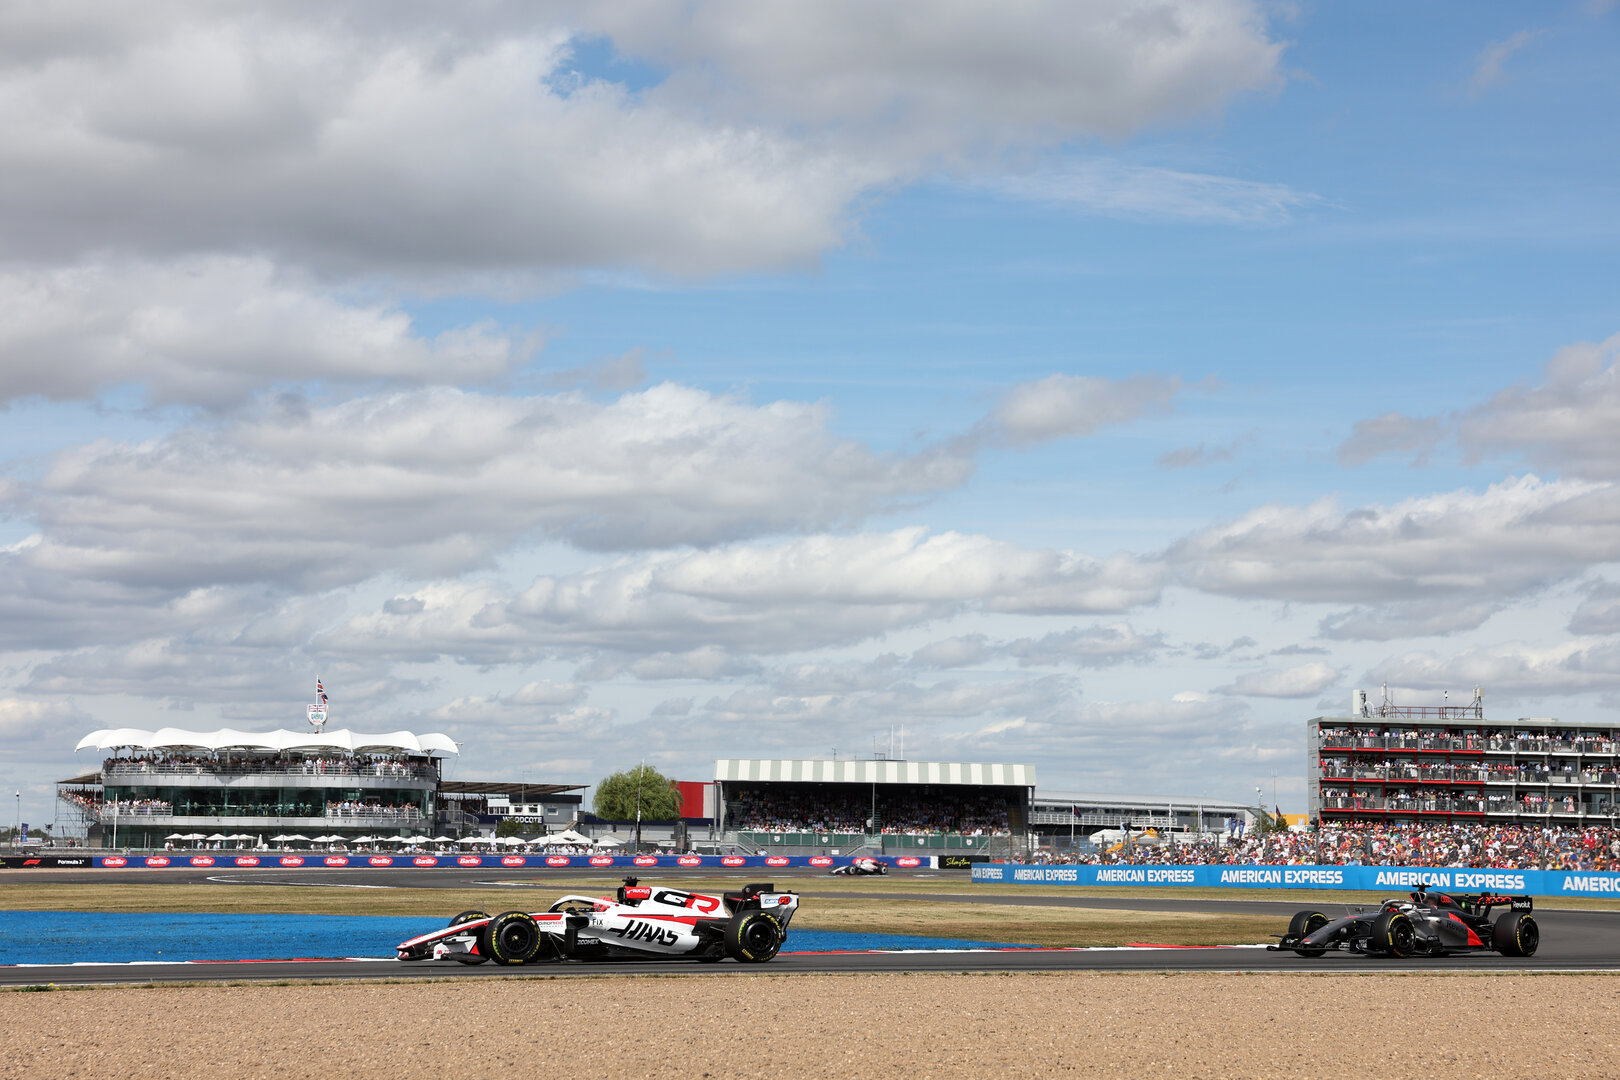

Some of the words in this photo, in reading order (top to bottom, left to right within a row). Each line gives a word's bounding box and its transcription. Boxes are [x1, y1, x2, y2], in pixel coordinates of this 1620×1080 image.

[502, 816, 543, 824] WODCOTE
[1014, 869, 1045, 881] AMERICAN
[1045, 869, 1078, 882] EXPRESS
[1096, 869, 1145, 882] AMERICAN
[1147, 870, 1195, 883] EXPRESS
[1221, 870, 1281, 883] AMERICAN
[1284, 871, 1343, 884] EXPRESS
[1375, 871, 1451, 887] AMERICAN
[1455, 873, 1525, 889] EXPRESS
[1512, 900, 1531, 909] Revolut
[607, 919, 679, 947] HAAS
